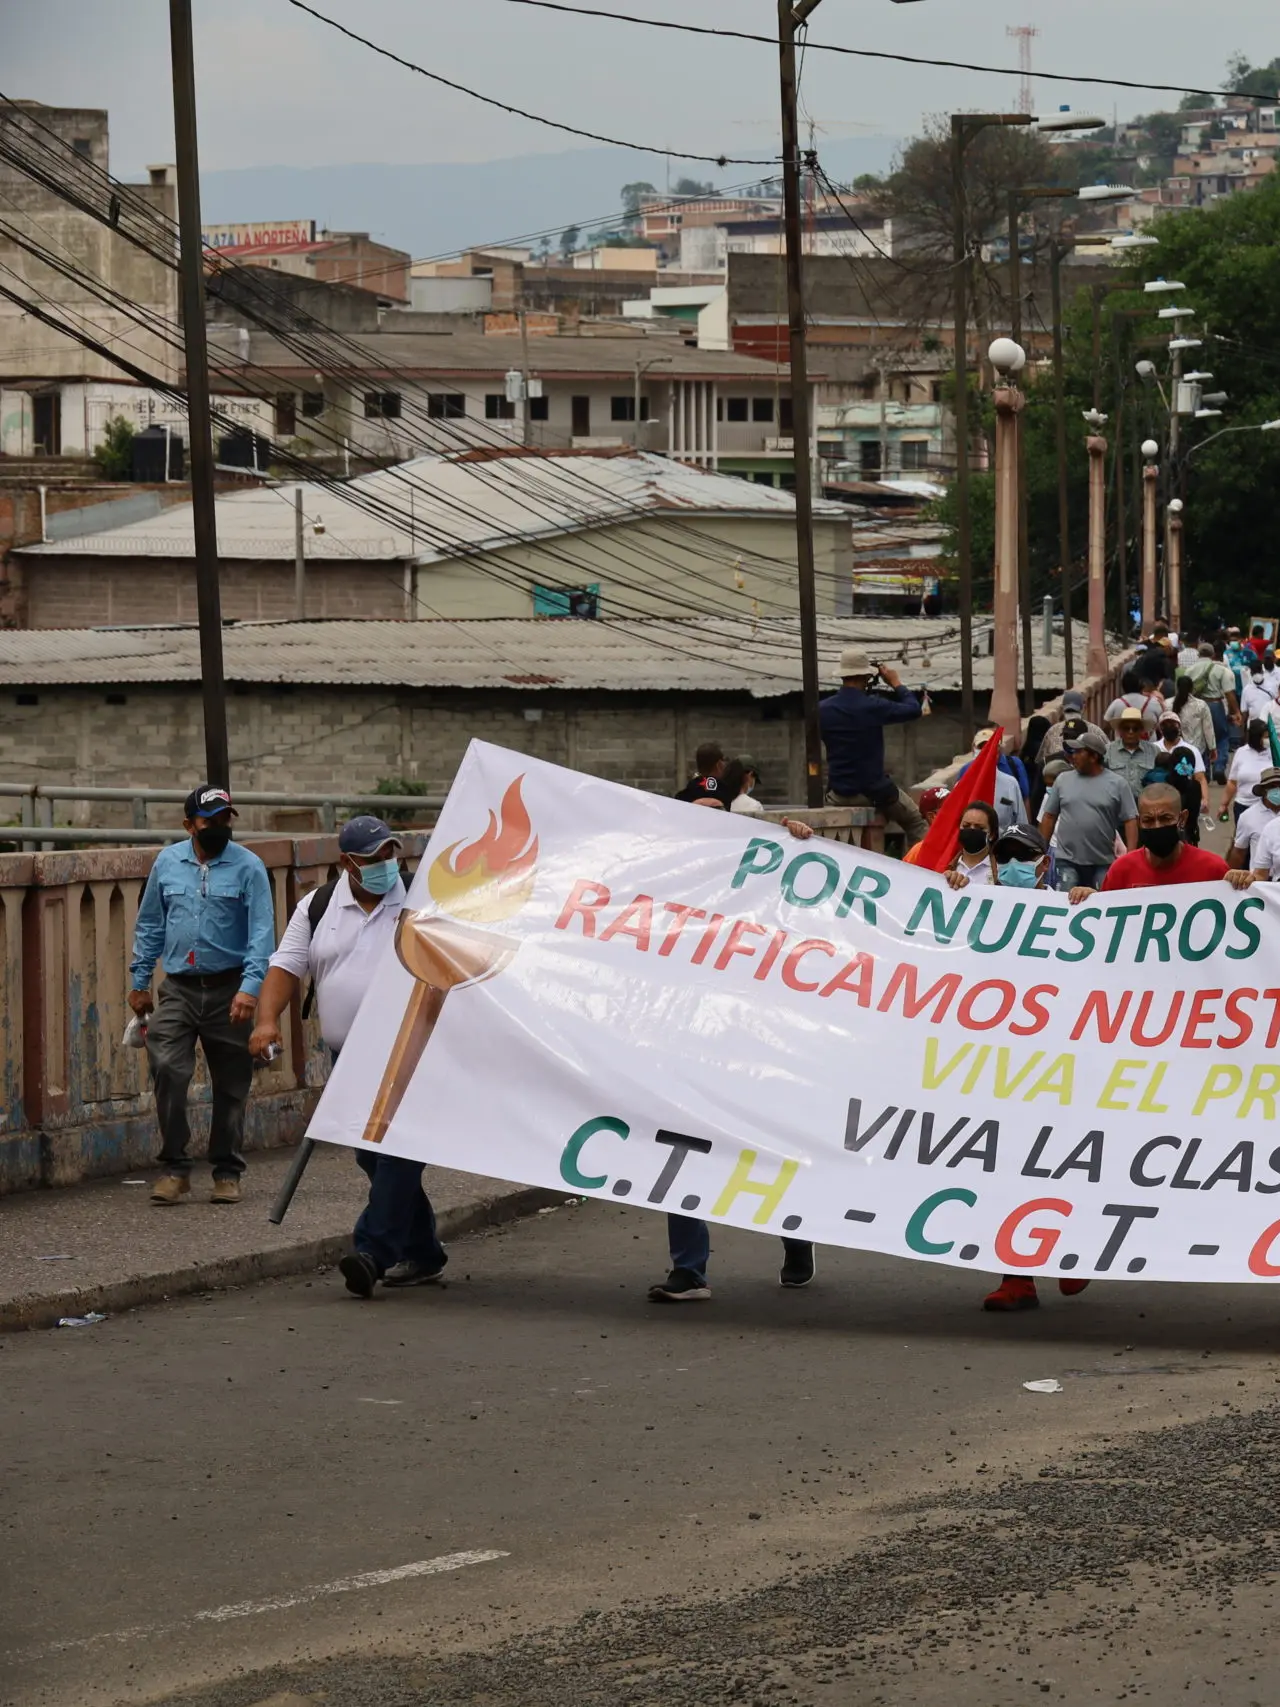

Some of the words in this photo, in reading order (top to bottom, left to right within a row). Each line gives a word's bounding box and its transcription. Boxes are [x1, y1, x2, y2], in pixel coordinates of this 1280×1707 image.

[253, 223, 309, 246] NORTEÑA
[731, 837, 890, 925] POR
[904, 887, 1265, 963] NUESTROS
[554, 878, 1060, 1037] RATIFICAMOS
[920, 1037, 1076, 1104] VIVA
[1096, 1059, 1170, 1114] EL
[843, 1097, 1000, 1173] VIVA
[1020, 1125, 1103, 1183] LA
[559, 1115, 803, 1231] C.T.H.
[905, 1187, 1160, 1273] C.G.T.
